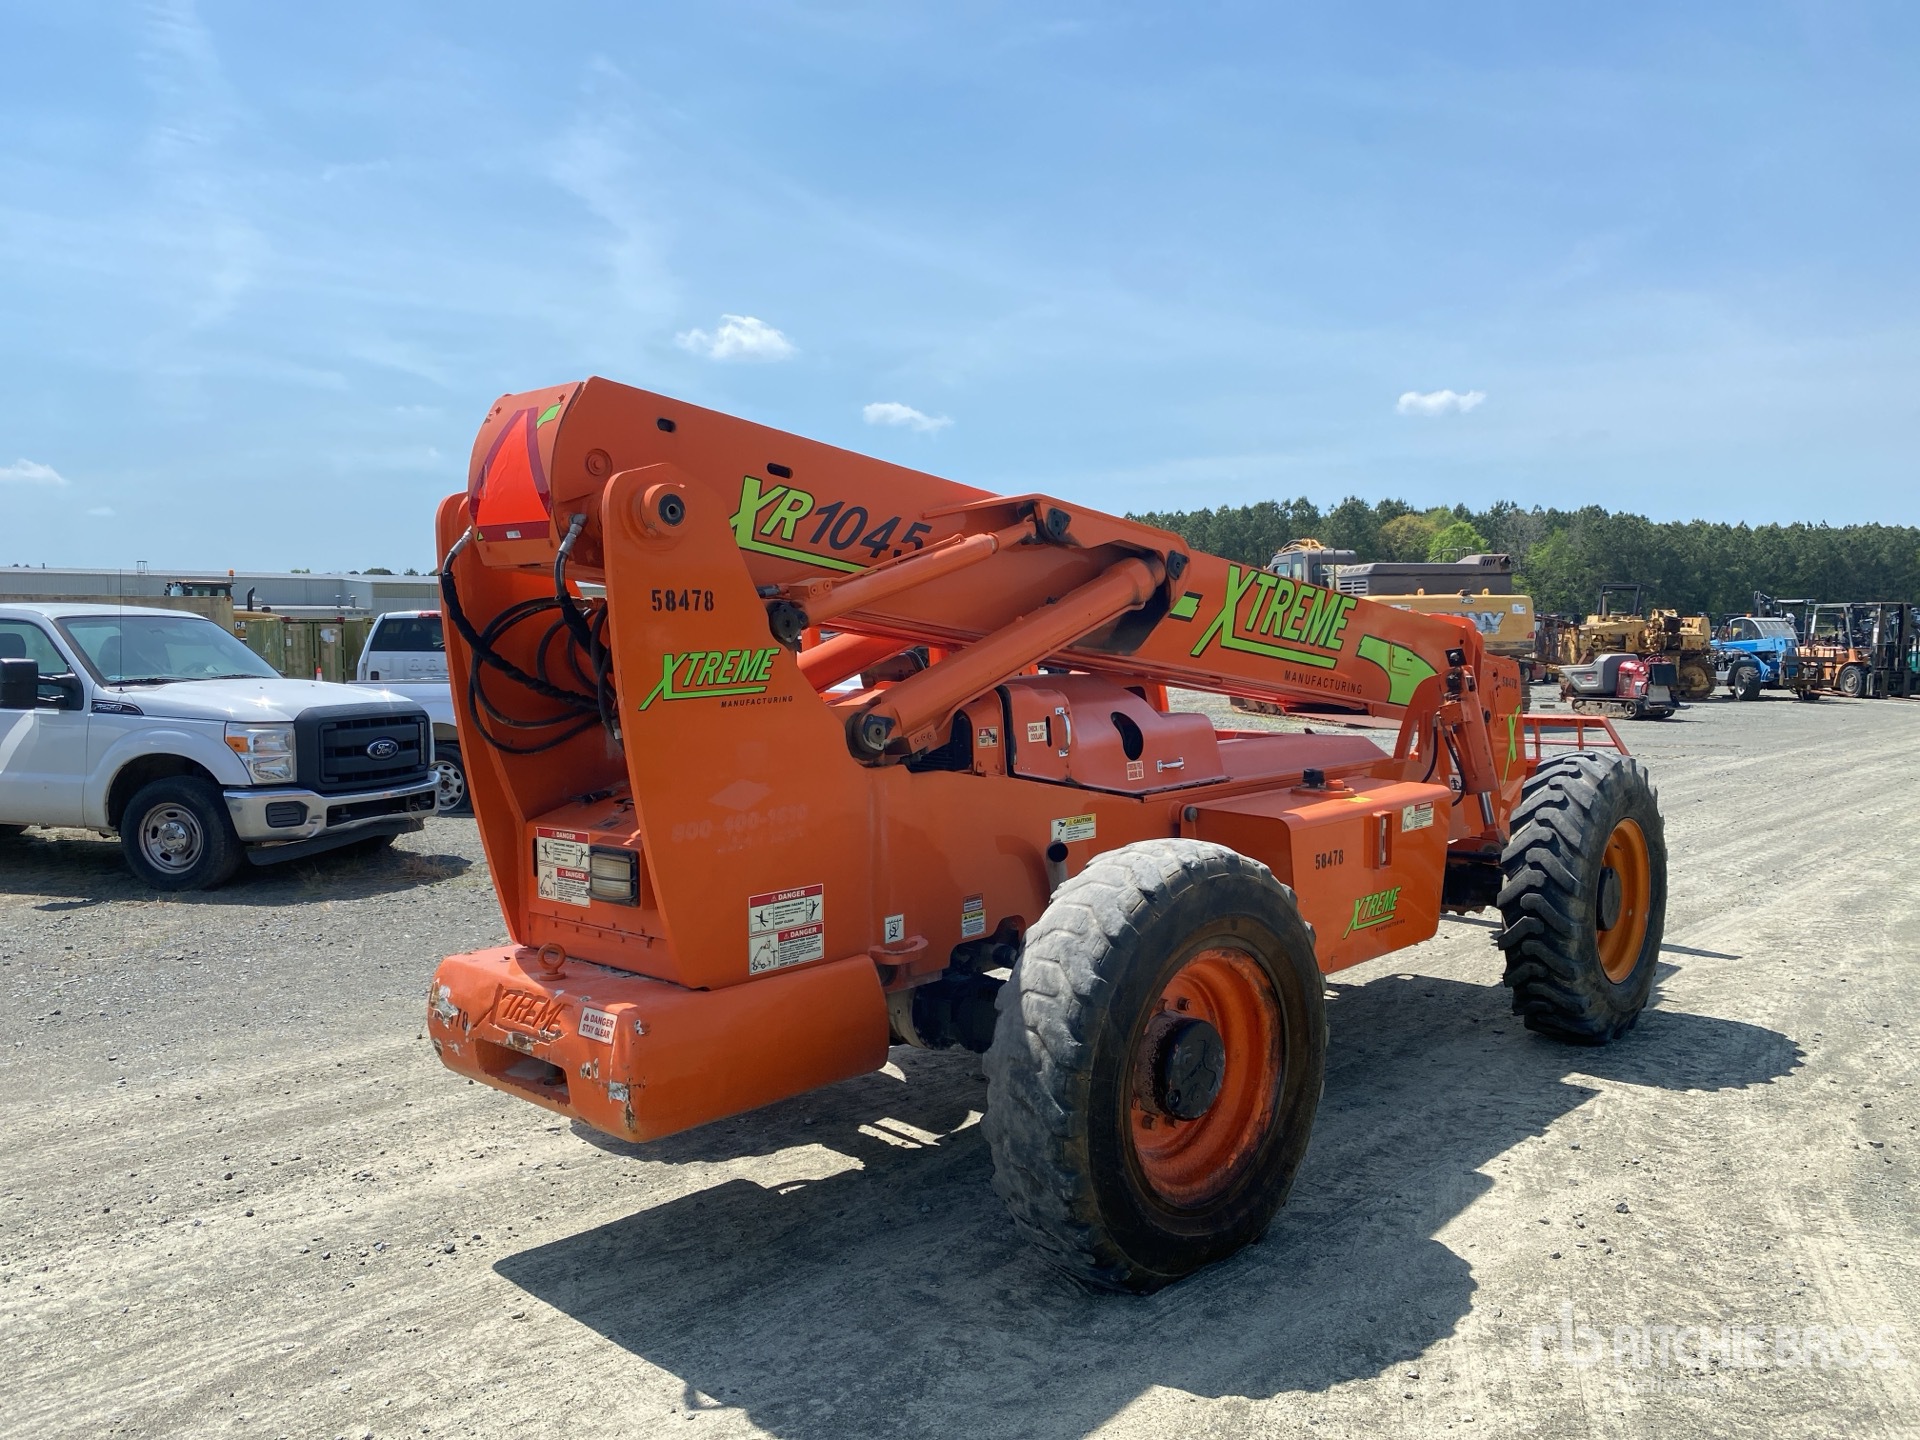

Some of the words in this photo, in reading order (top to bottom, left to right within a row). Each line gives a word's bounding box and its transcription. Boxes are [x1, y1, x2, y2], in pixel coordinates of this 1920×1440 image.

[651, 589, 714, 612] 58478
[1190, 564, 1358, 669] XTREME
[638, 648, 781, 711] XTREME
[1284, 670, 1363, 695] MANUFACTURING
[720, 695, 793, 708] MANUFACTURING
[556, 831, 576, 840] DANGER
[1315, 850, 1344, 870] 58478
[565, 872, 585, 880] DANGER
[778, 890, 806, 901] DANGER
[1342, 886, 1401, 940] XTREME
[790, 927, 817, 938] DANGER
[589, 1014, 614, 1028] DANGER
[582, 1024, 594, 1034] STAY
[594, 1026, 611, 1039] CLEAR
